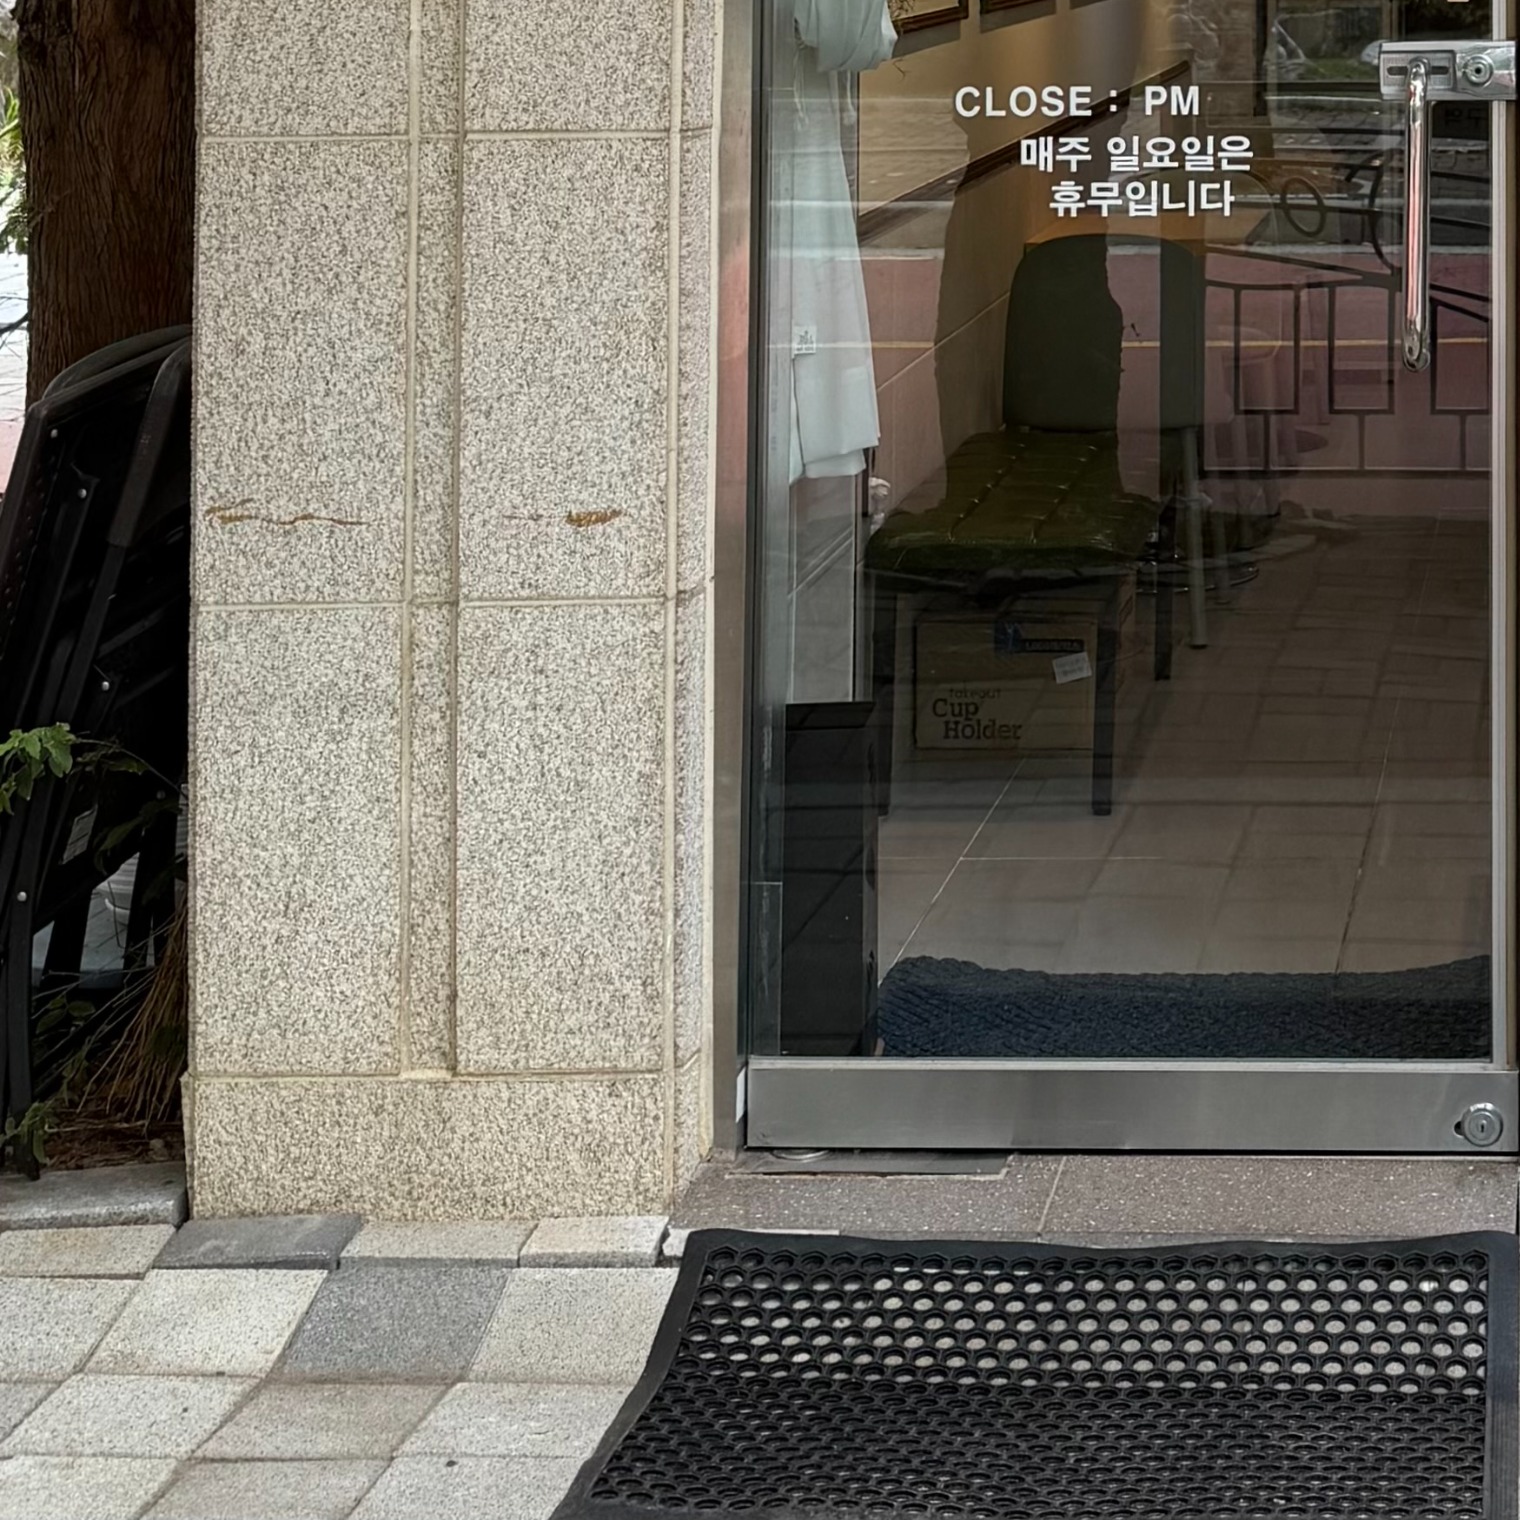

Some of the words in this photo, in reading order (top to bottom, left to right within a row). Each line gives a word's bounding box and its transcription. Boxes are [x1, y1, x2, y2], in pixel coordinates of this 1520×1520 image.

[954, 85, 1093, 118] CLOSE
[1144, 85, 1200, 116] PM
[1020, 135, 1093, 172] 매주
[1106, 135, 1254, 172] 일요일은
[1049, 180, 1236, 217] 휴무입니다
[932, 698, 980, 720] Cup
[943, 719, 1023, 741] Holder
